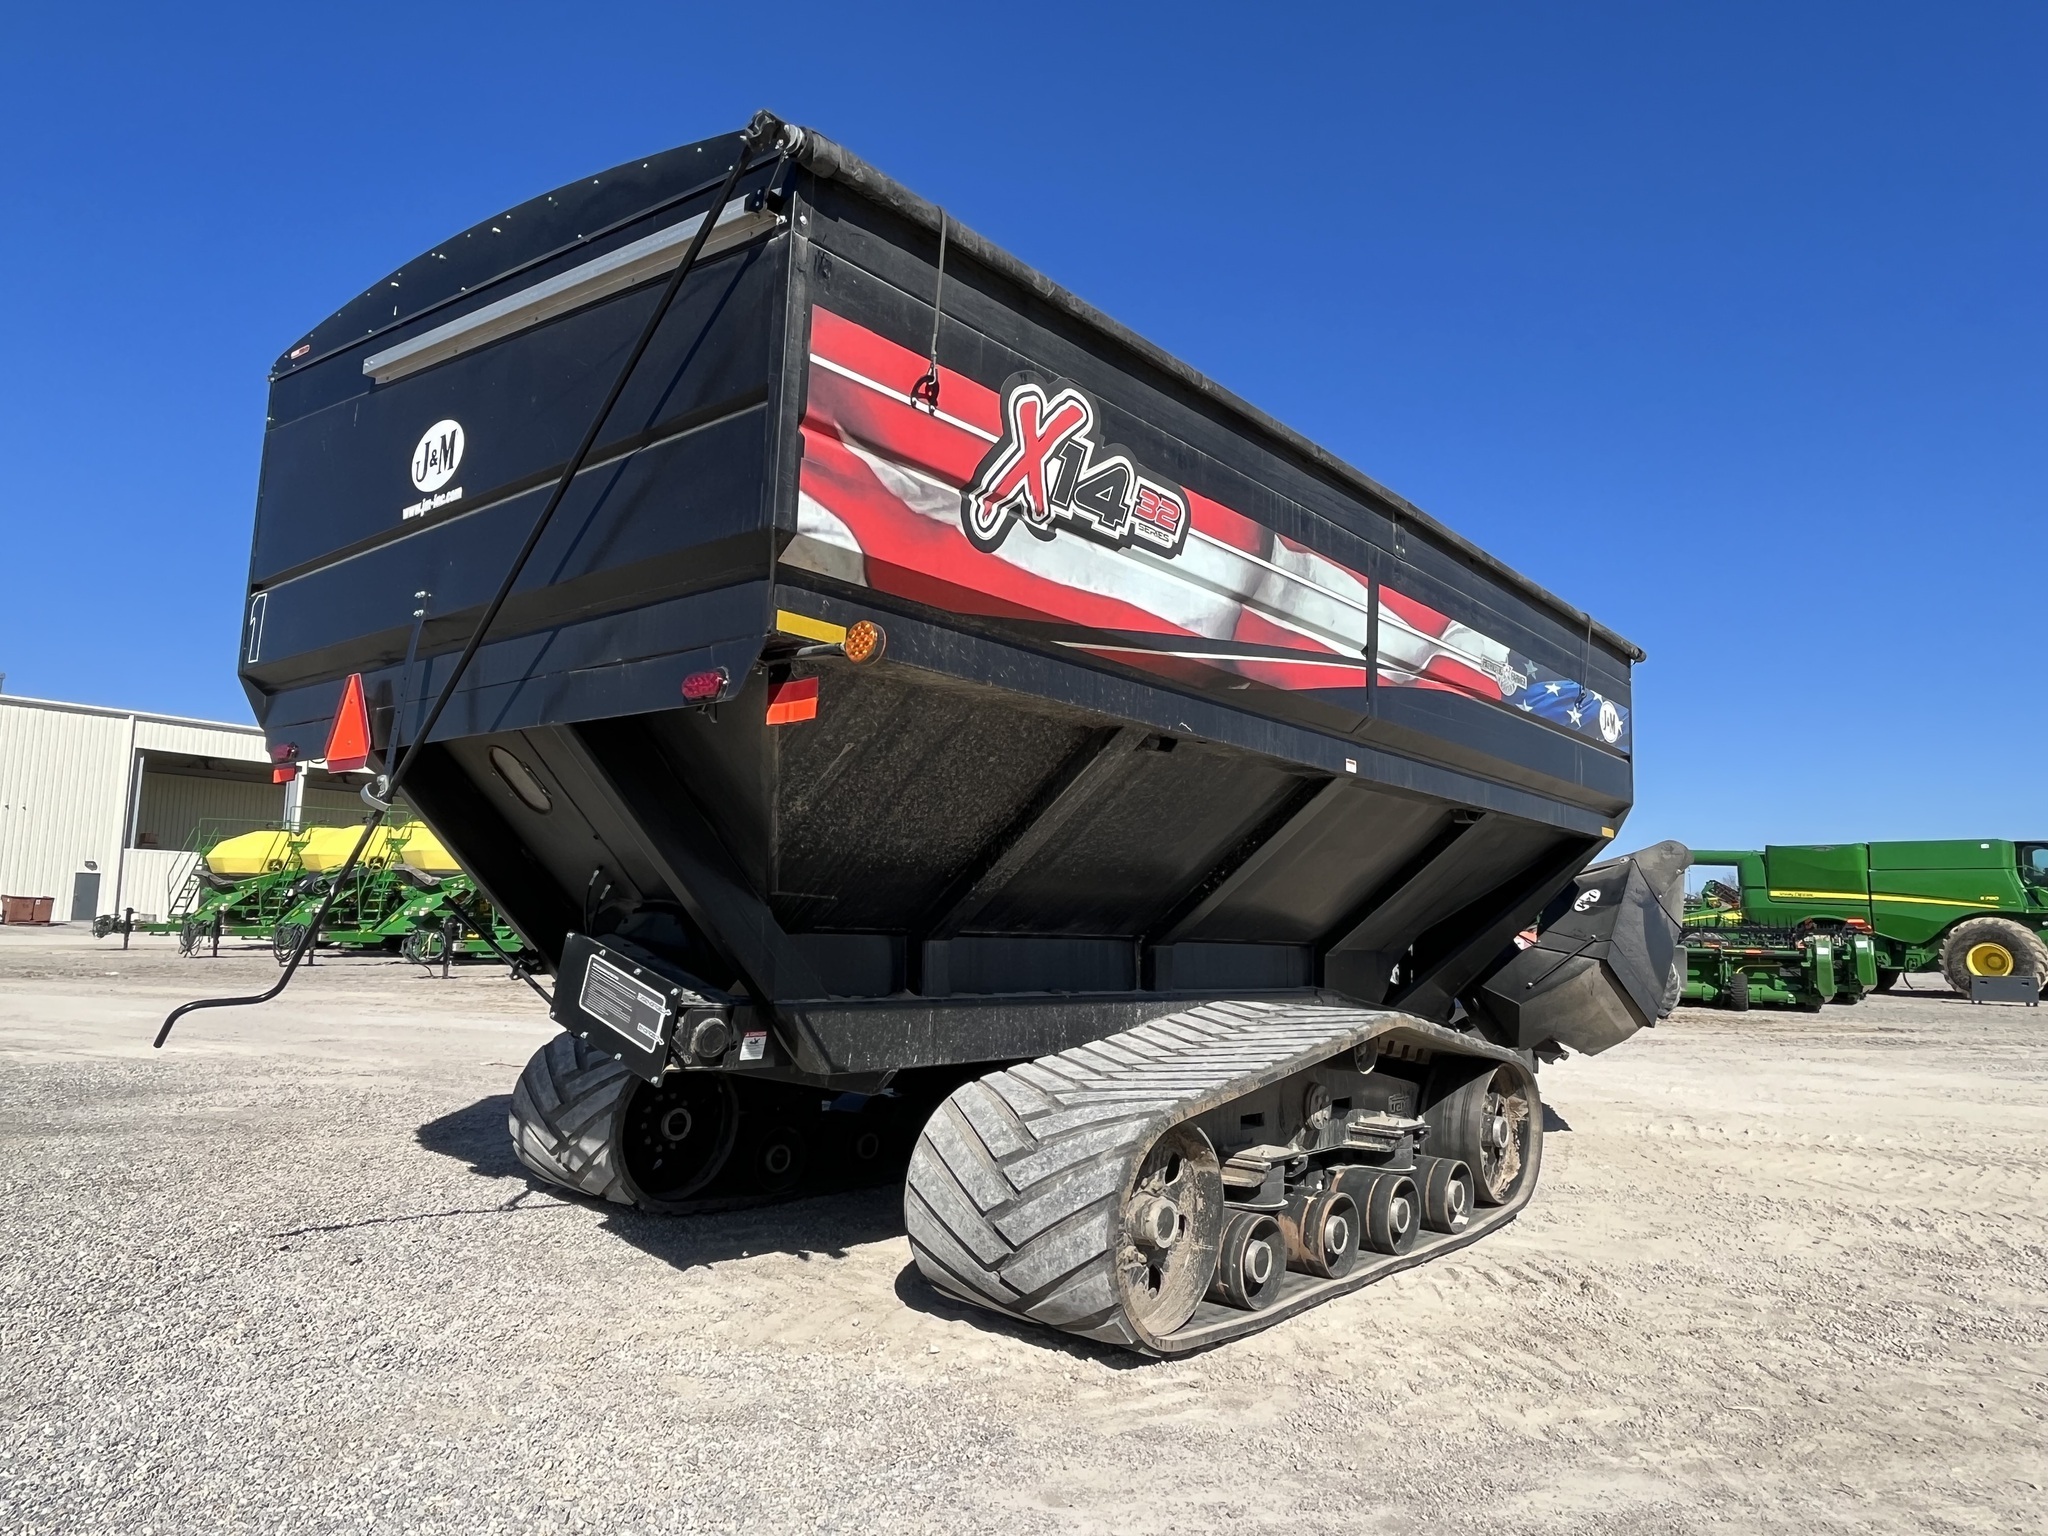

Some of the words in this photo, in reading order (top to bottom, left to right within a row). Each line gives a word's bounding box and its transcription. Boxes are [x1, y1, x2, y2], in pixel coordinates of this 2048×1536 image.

[415, 428, 458, 483] J&M
[1133, 487, 1181, 533] 32
[1138, 522, 1170, 543] SERIES
[1602, 709, 1617, 736] J&M
